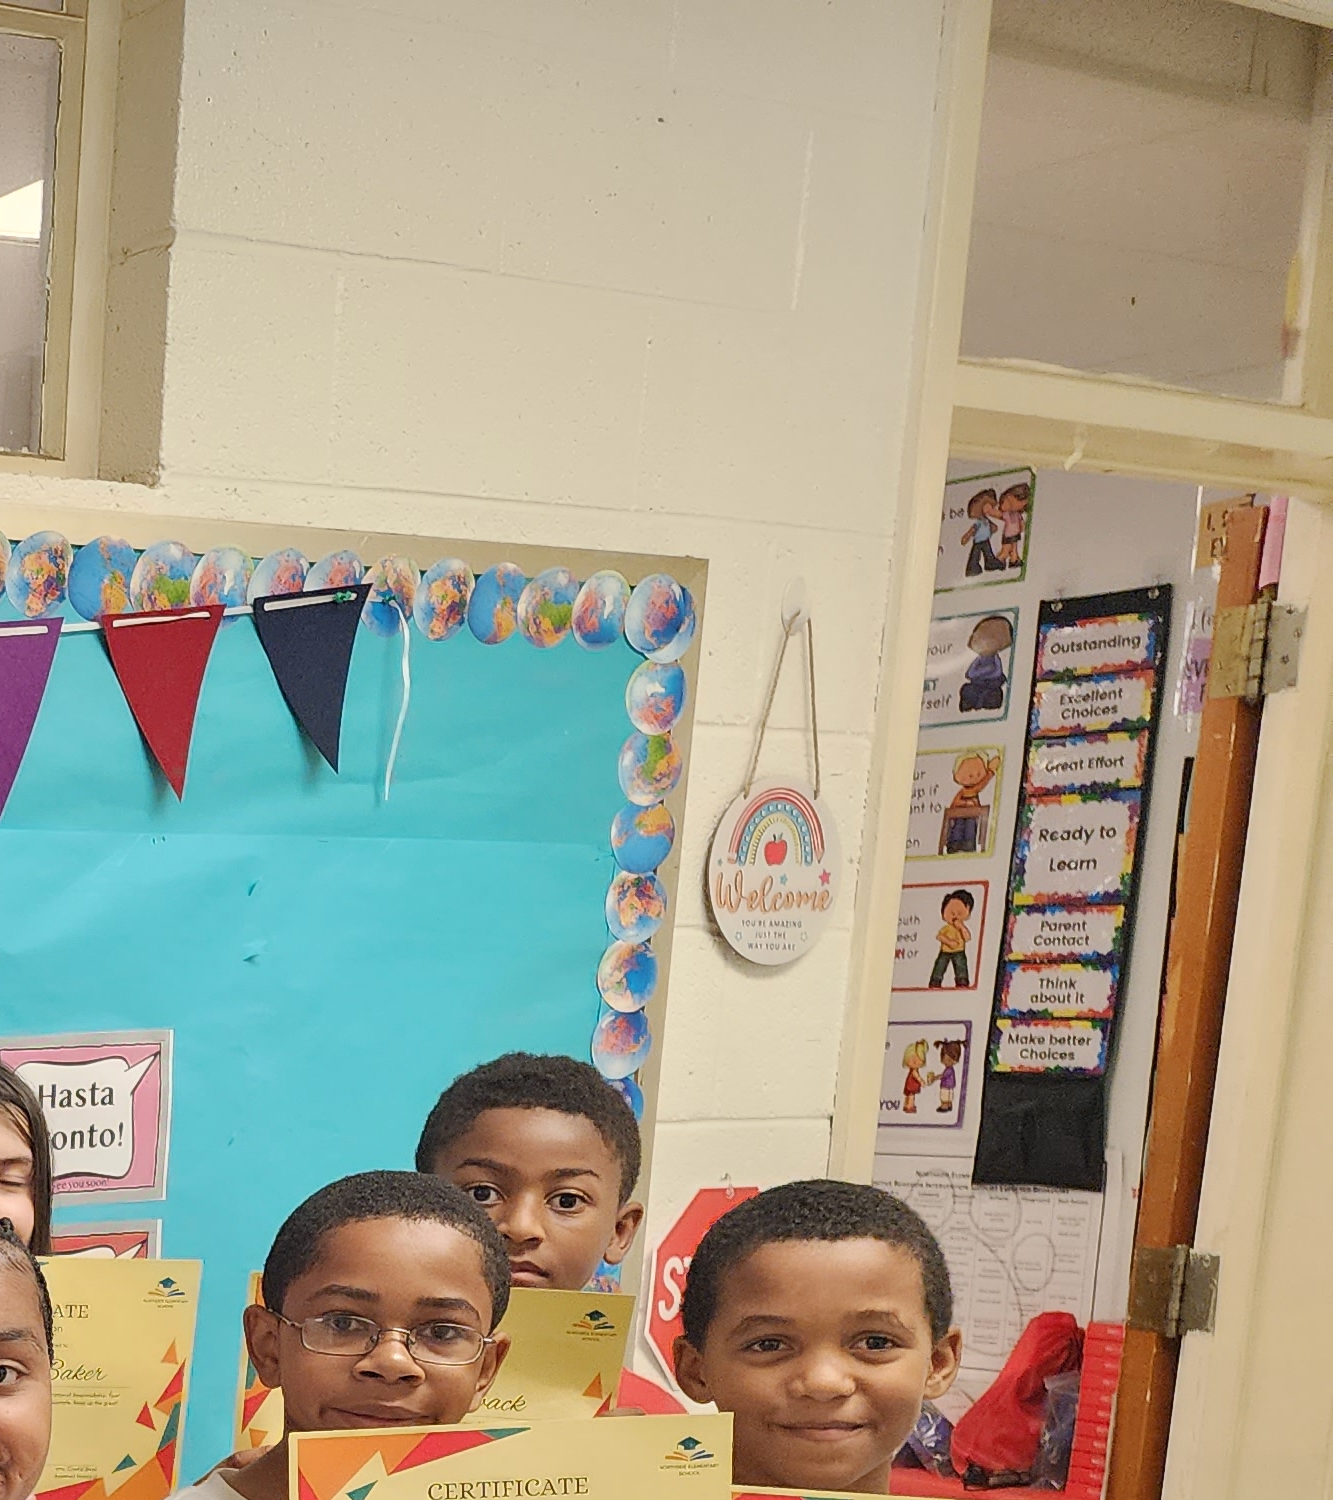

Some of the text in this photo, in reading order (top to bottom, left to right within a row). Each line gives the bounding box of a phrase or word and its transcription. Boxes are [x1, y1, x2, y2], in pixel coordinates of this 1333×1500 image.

[949, 508, 964, 519] be
[1050, 634, 1141, 655] Outstanding
[1060, 687, 1123, 706] Excellent
[1061, 704, 1119, 720] Choices
[1045, 756, 1124, 773] Great Effort
[930, 802, 942, 813] to
[1039, 824, 1117, 844] Ready to
[1049, 858, 1097, 872] Learn
[716, 870, 833, 913] Welcome
[769, 920, 802, 928] AMAZING
[1041, 920, 1087, 932] Parent
[1033, 935, 1090, 947] Contact
[907, 949, 918, 959] or
[1039, 977, 1076, 989] Think
[1030, 992, 1085, 1004] about it
[1008, 1033, 1092, 1047] Make better
[1019, 1048, 1075, 1061] Choices
[68, 1181, 84, 1191] you
[51, 1359, 107, 1380] Baker
[427, 1477, 589, 1500] CERTIFICATE
